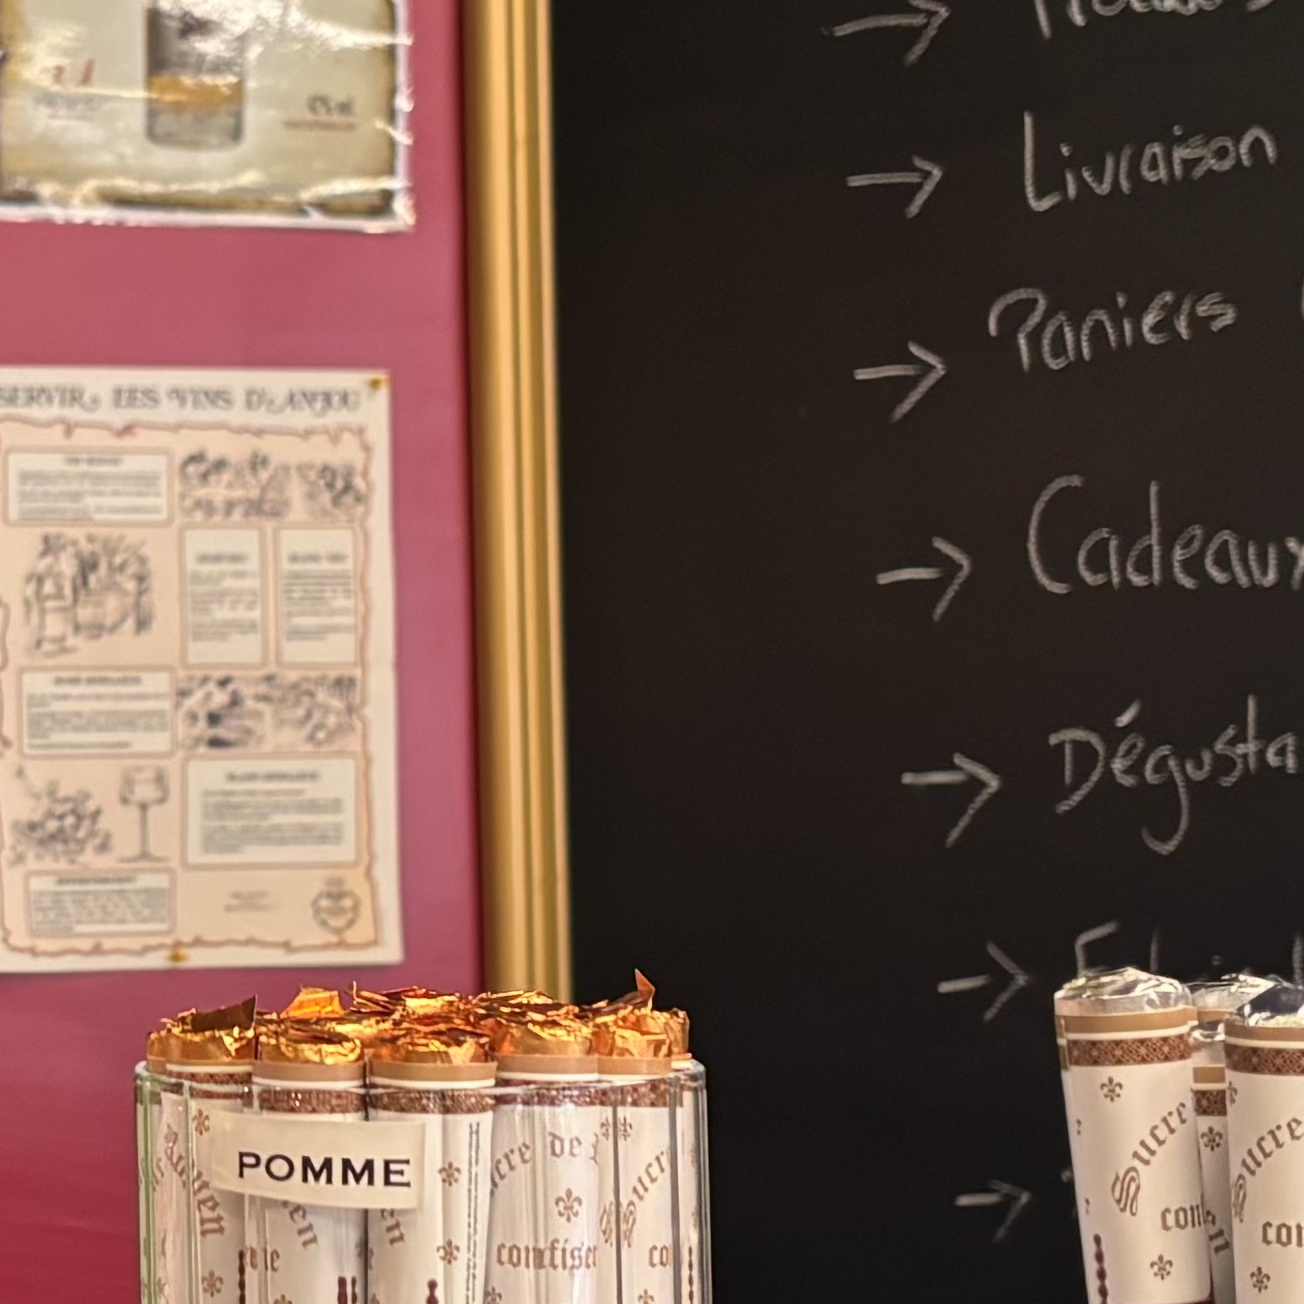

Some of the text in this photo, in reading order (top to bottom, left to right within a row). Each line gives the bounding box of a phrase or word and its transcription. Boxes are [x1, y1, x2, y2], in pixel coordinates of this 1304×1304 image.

[1023, 110, 1278, 213] Livraison
[988, 286, 1238, 375] Paniers
[238, 1151, 412, 1188] POMME
[550, 1131, 582, 1159] de
[1111, 1101, 1187, 1217] Sucre
